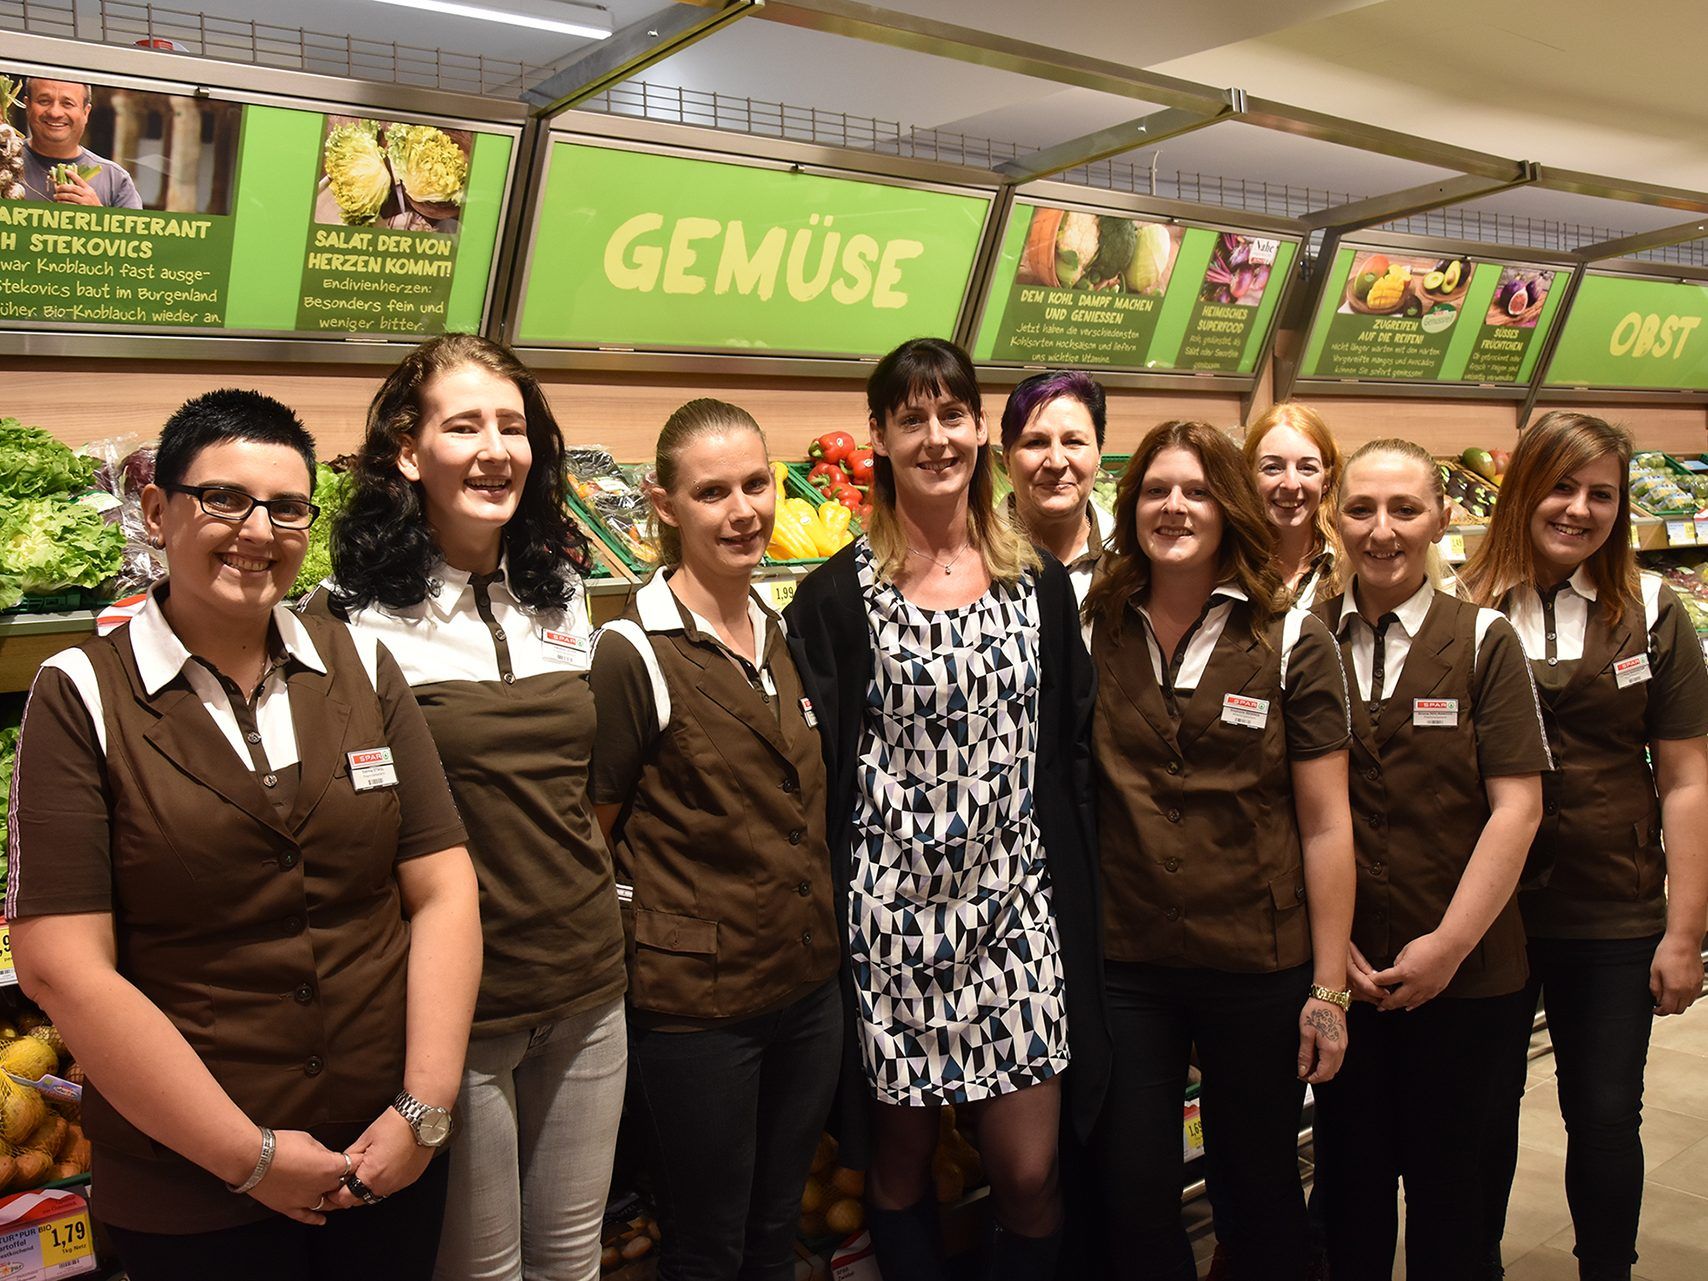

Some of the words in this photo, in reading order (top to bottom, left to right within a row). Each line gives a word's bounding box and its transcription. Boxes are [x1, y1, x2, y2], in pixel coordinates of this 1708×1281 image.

[29, 233, 153, 259] STEKOVICS
[315, 230, 373, 252] SALAT,
[377, 235, 412, 253] DER
[415, 238, 452, 256] VON
[308, 252, 382, 273] HERZEN
[385, 257, 452, 277] KOMMT!
[604, 212, 925, 309] GEMÜSE
[37, 258, 114, 277] Knoblauch
[120, 263, 155, 280] fast
[160, 268, 211, 286] ausge-
[76, 280, 110, 299] baut
[116, 286, 132, 300] im
[138, 287, 218, 306] Burgenland
[323, 277, 432, 294] Endivienherzen:
[304, 296, 382, 312] Besonders
[387, 299, 415, 312] fein
[420, 301, 444, 314] und
[1020, 290, 1045, 303] DEM
[1048, 292, 1073, 305] KOHL
[1078, 294, 1112, 308] DAMPF
[1114, 297, 1154, 312] MACHEN
[43, 304, 146, 322] Bio-Knoblauch
[152, 308, 197, 323] wieder
[203, 314, 222, 324] an.
[1045, 307, 1067, 320] UND
[1071, 309, 1124, 324] GENIESSEN
[1202, 305, 1248, 320] HEIMISCHES
[319, 317, 374, 332] weniger
[380, 316, 424, 331] bitter.
[1016, 322, 1040, 333] Jetzt
[1042, 323, 1064, 334] haben
[1066, 325, 1078, 335] die
[1080, 327, 1139, 339] verschiedensten
[1197, 319, 1244, 334] SUPERFOOD
[1373, 319, 1418, 331] ZUGREIFEN
[1010, 336, 1053, 348] Kohlsorten
[1098, 341, 1112, 351] und
[1113, 342, 1136, 352] liefern
[1358, 331, 1377, 342] AUF
[1377, 332, 1392, 343] DIE
[1609, 311, 1701, 360] OBST
[1032, 353, 1046, 362] uns
[1048, 353, 1079, 363] wichtige
[776, 586, 794, 600] 1,99
[1233, 699, 1257, 708] SPAR
[359, 753, 382, 763] SPAR
[38, 1224, 52, 1233] BIO
[51, 1221, 85, 1248] 1,79
